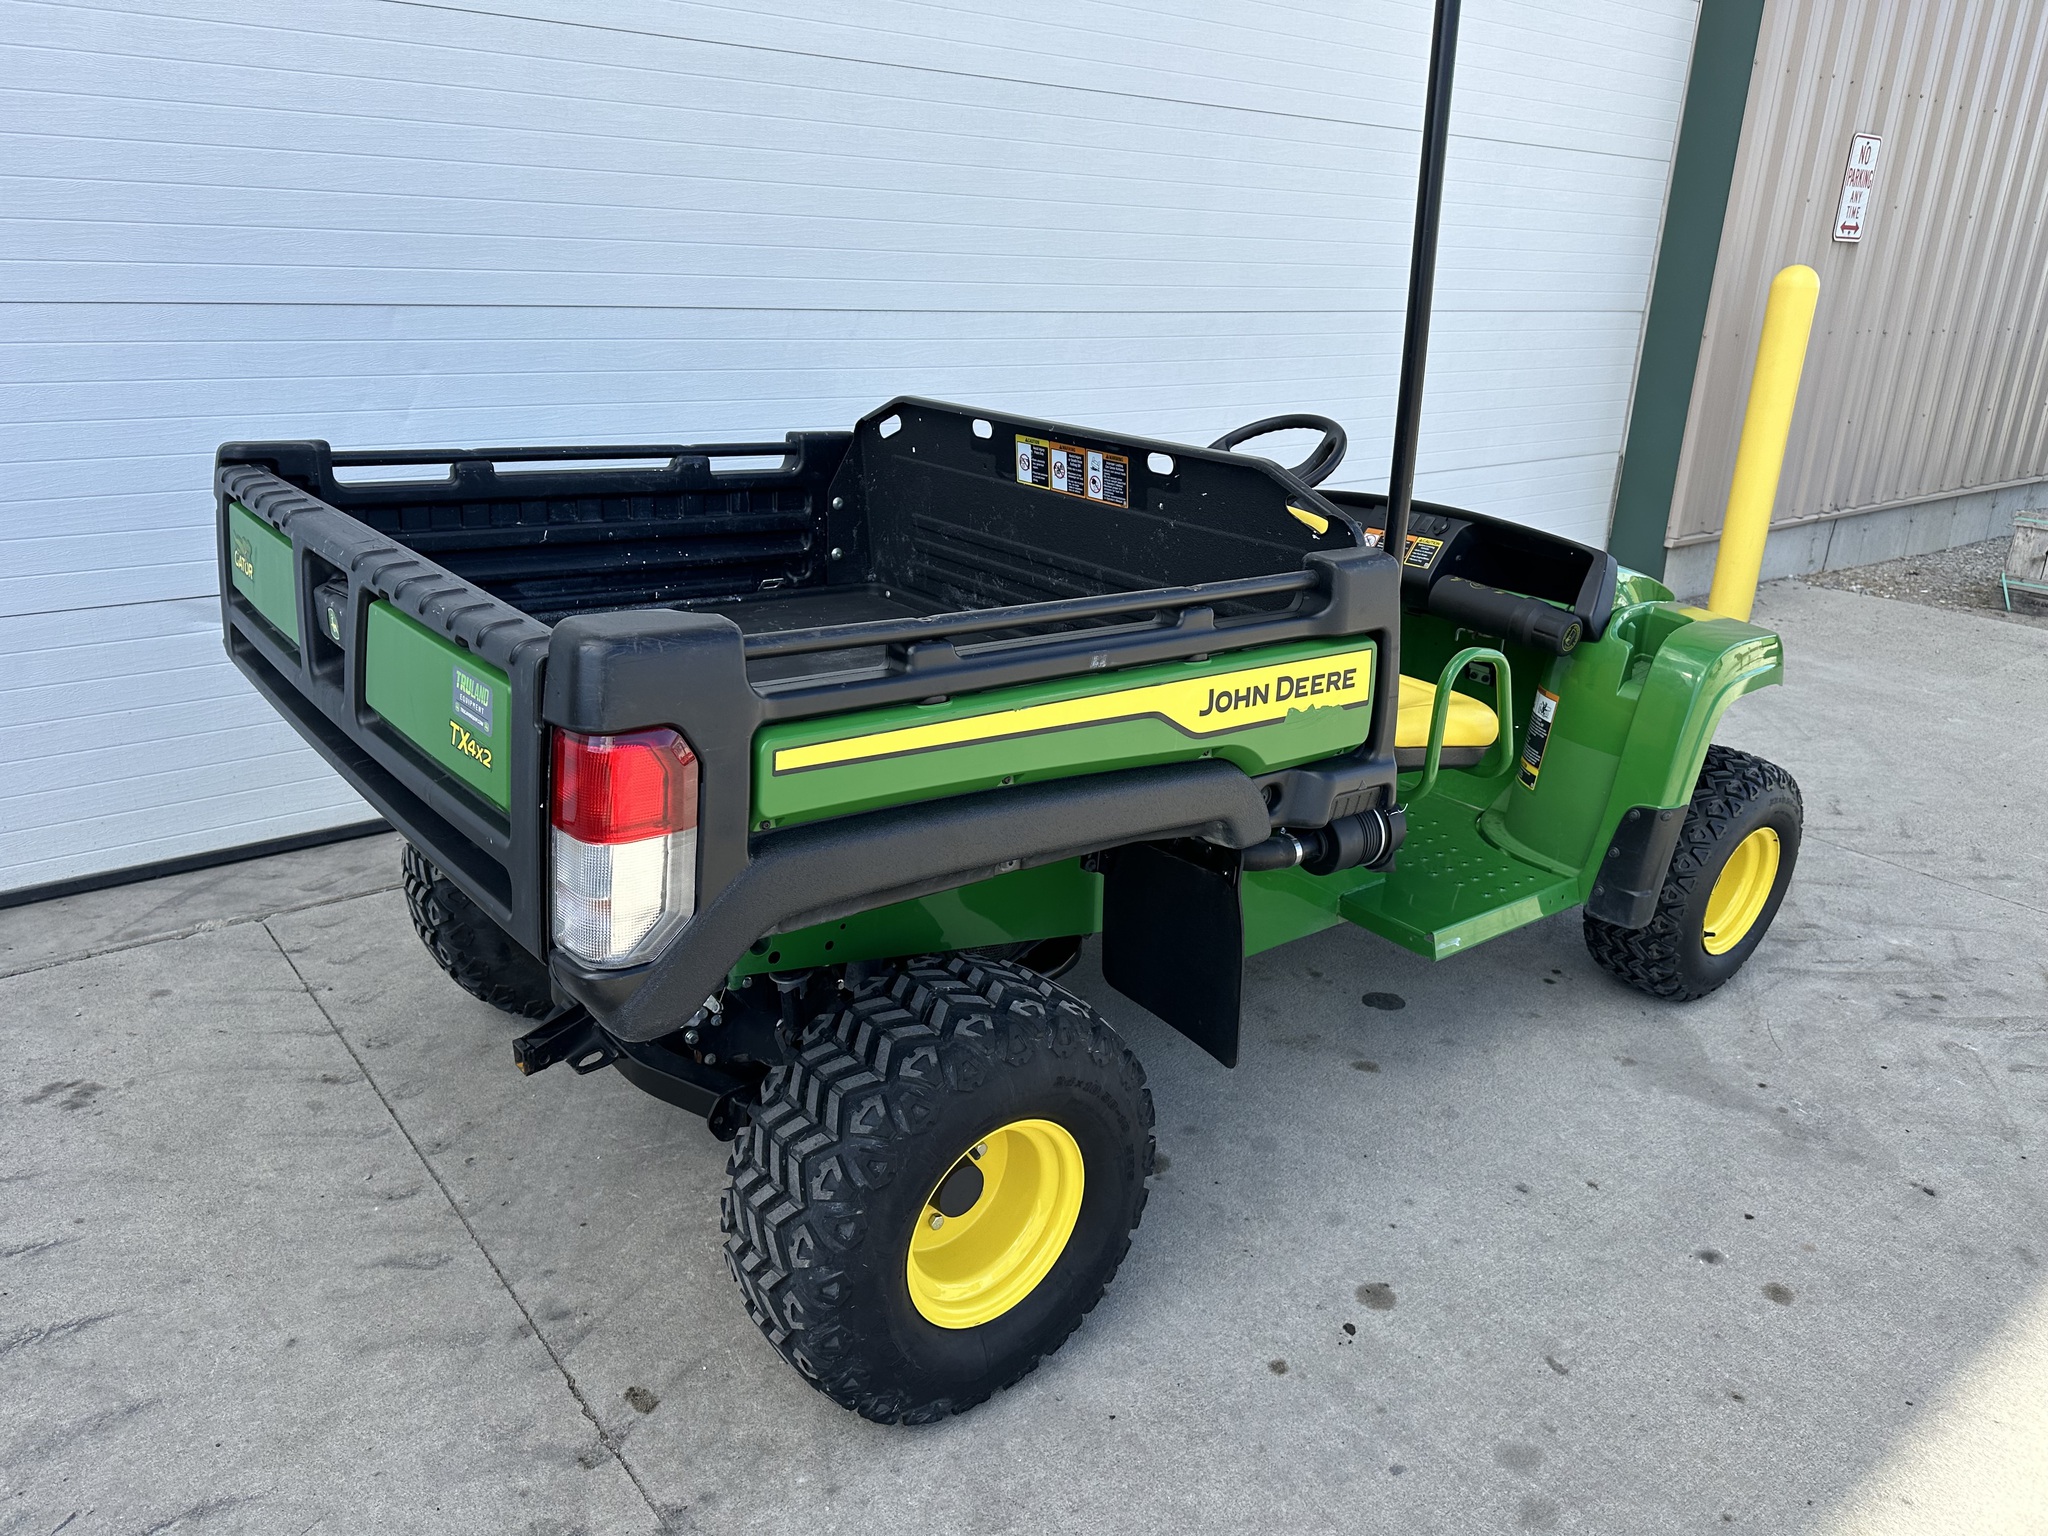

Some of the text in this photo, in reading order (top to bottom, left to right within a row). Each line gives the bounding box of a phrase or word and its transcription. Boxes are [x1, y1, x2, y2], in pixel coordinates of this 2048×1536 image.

[1858, 145, 1872, 165] NO
[1846, 167, 1874, 189] PARKING
[1850, 190, 1864, 204] ANY
[1845, 205, 1861, 220] TIME
[1421, 538, 1441, 546] CAUTION
[234, 550, 253, 584] GATOR
[456, 670, 490, 707] TRULAND
[1198, 668, 1358, 717] JOHN DEERE
[459, 693, 485, 715] EQUIPMENT
